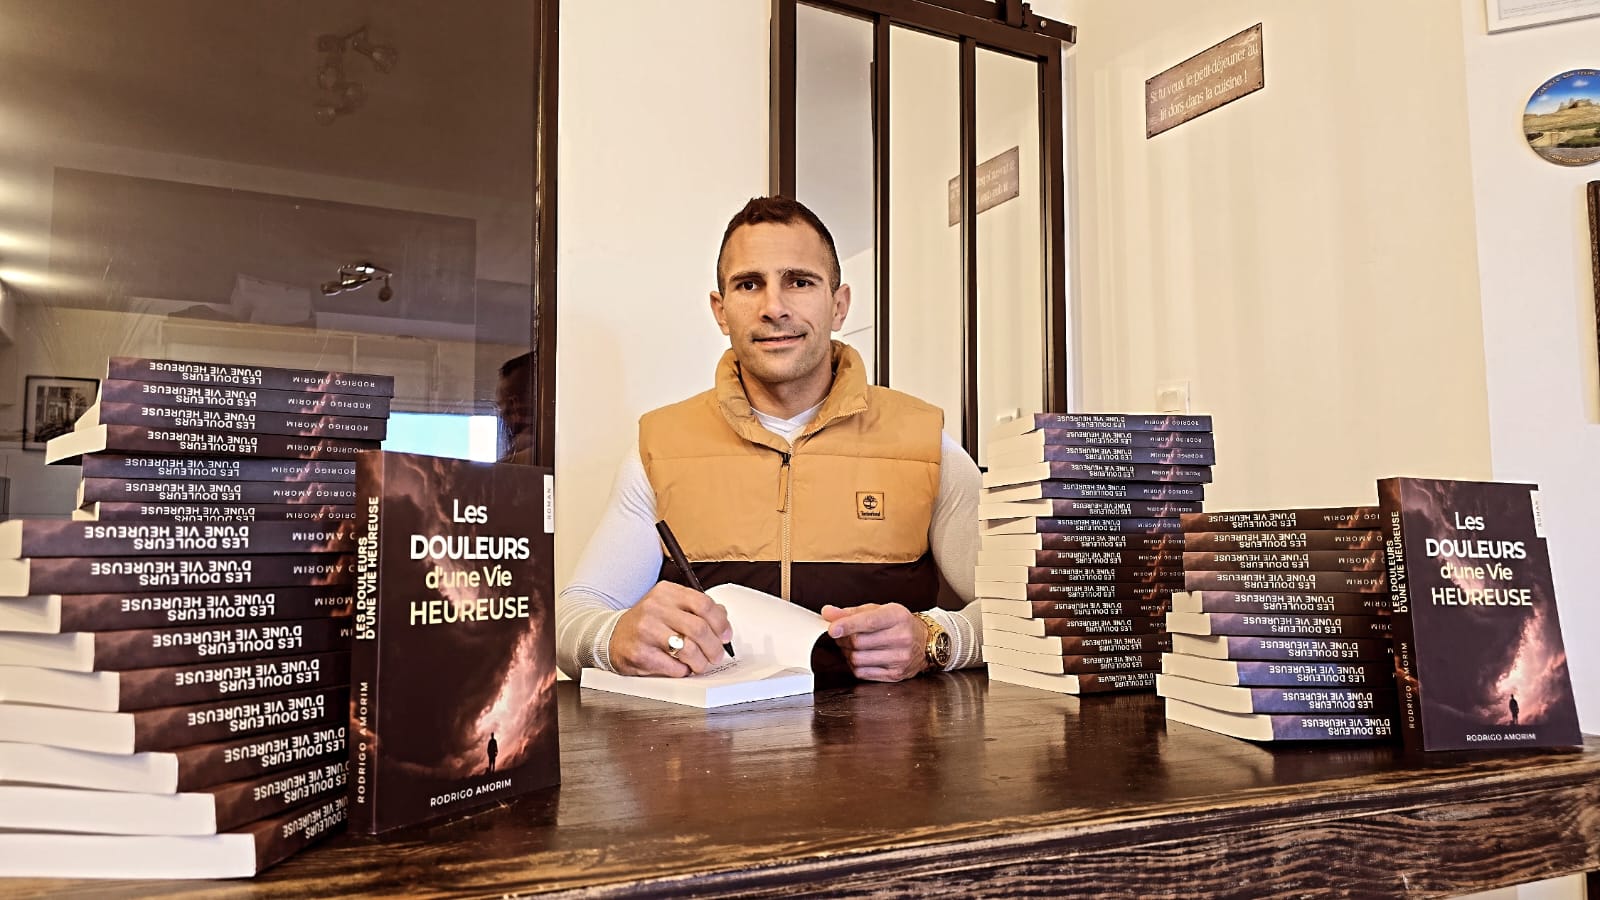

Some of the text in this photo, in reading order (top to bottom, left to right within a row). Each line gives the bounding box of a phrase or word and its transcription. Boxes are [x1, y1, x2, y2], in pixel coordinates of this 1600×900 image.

[1167, 79, 1184, 96] veux
[1248, 43, 1259, 56] au
[1168, 102, 1184, 117] dors
[1186, 92, 1203, 109] dans
[1206, 87, 1213, 103] la
[1214, 74, 1242, 96] cuisine
[150, 362, 262, 377] D'UNE VIE HEUREUSE
[182, 372, 262, 384] LES DOULEURS
[292, 376, 375, 388] RODRIGO AMORIM
[142, 385, 256, 400] D'UNE VIE HEUREUSE
[175, 395, 256, 407] LES DOULEURS
[287, 398, 371, 409] RODRIGO AMORIM
[141, 408, 255, 422] D'UNE VIE HEUREUSE
[175, 417, 255, 429] LES DOULEURS
[147, 431, 257, 445] D'UNE VIE HEUREUSE
[180, 441, 257, 453] LES DOULEURS
[125, 459, 240, 468] D'UNE VIE HEUREUSE
[158, 467, 240, 477] LES DOULEURS
[453, 499, 488, 524] Les
[1208, 512, 1296, 522] D'UNE VIE HEUREUSE
[1232, 520, 1277, 528] DOULEURS
[1455, 512, 1485, 531] Les
[84, 526, 249, 538] D'UNE VIE HEUREUSE
[292, 531, 344, 540] AMORIM
[1261, 533, 1275, 541] VIE
[133, 537, 249, 550] LES DOULEURS
[410, 535, 530, 560] DOULEURS
[1239, 540, 1286, 548] DOULEURS
[1426, 539, 1526, 559] DOULEURS
[90, 560, 251, 575] D'UNE VIE HEUREUSE
[366, 496, 379, 639] D'UNE VIE HEUREUSE
[1391, 511, 1408, 612] D'UNE VIE HEUREUSE
[293, 565, 343, 574] AMORIM
[425, 565, 512, 589] d'une Vie
[1387, 540, 1400, 612] LES DOULEURS
[1440, 563, 1513, 580] d'une Vie
[139, 570, 251, 586] LES DOULEURS
[356, 537, 367, 639] LES DOULEURS
[121, 594, 275, 612] D'UNE VIE HEUREUSE
[1234, 594, 1334, 603] D'UNE VIE HEUREUSE
[1432, 588, 1532, 606] HEUREUSE
[167, 604, 275, 621] LES DOULEURS
[410, 596, 529, 625] HEUREUSE
[1263, 602, 1334, 611] LES DOULEURS
[1243, 617, 1291, 625] HEUREUSE
[1313, 618, 1341, 626] D'UNE
[152, 625, 302, 647] D'UNE VIE HEUREUSE
[1271, 625, 1342, 634] LES DOULEURS
[198, 636, 302, 656] LES DOULEURS
[1260, 640, 1308, 649] HEUREUSE
[1311, 641, 1326, 649] VIE
[1288, 649, 1359, 658] LES DOULEURS
[175, 659, 320, 685] D'UNE VIE HEUREUSE
[219, 670, 320, 693] LES DOULEURS
[1401, 642, 1415, 728] RODRIGO AMORIM
[187, 694, 324, 725] D'UNE VIE HEUREUSE
[229, 706, 324, 732] LES DOULEURS
[1302, 719, 1391, 727] D'UNE VIE HEUREUSE
[1328, 727, 1391, 736] LES DOULEURS
[1466, 733, 1536, 742] RODRIGO AMORIM
[224, 727, 345, 763] D'UNE VIE HEUREUSE
[357, 682, 368, 804] RODRIGO AMORIM
[261, 739, 345, 767] LES DOULEURS
[430, 778, 511, 807] RODRIGO AMORIM
